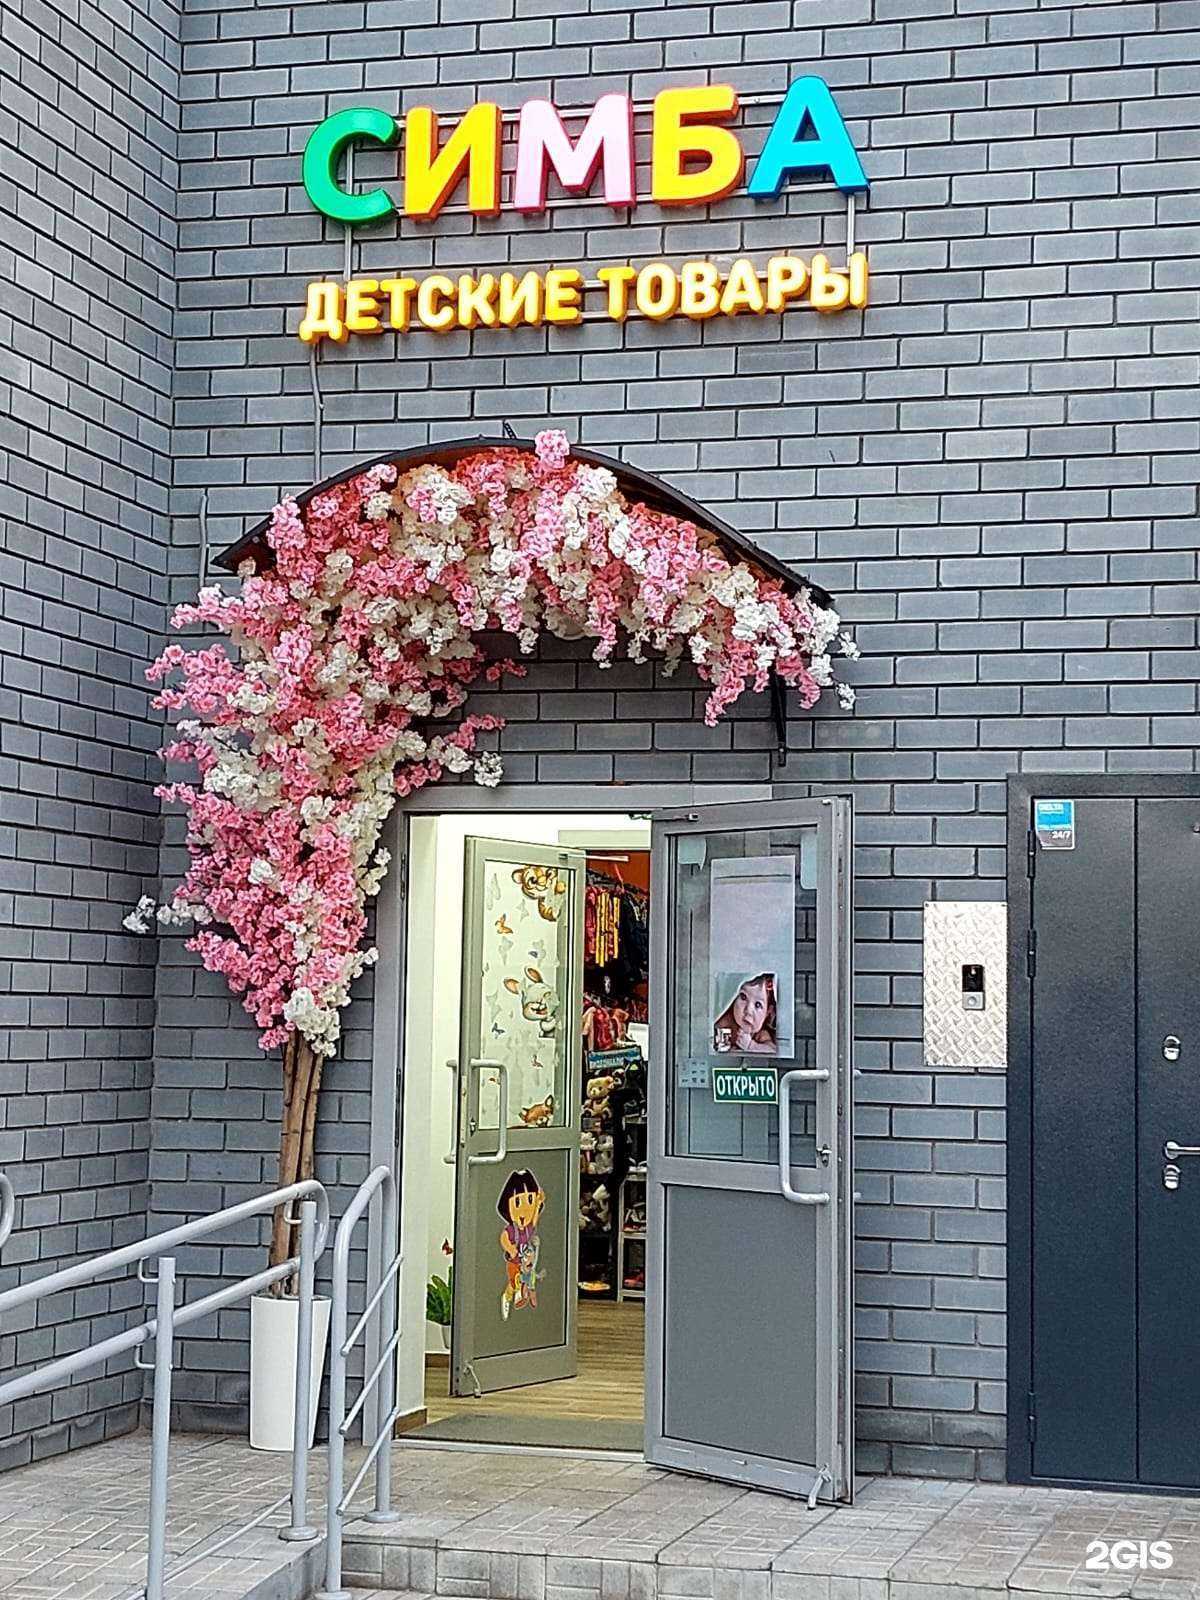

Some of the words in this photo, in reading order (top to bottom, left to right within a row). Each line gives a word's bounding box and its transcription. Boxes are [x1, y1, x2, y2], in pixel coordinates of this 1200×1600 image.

[302, 75, 868, 222] СИМБА
[299, 270, 583, 343] ДЕТСКИЕ
[598, 252, 868, 323] ТОВАРЫ
[716, 1075, 775, 1097] ОТКРЫТО
